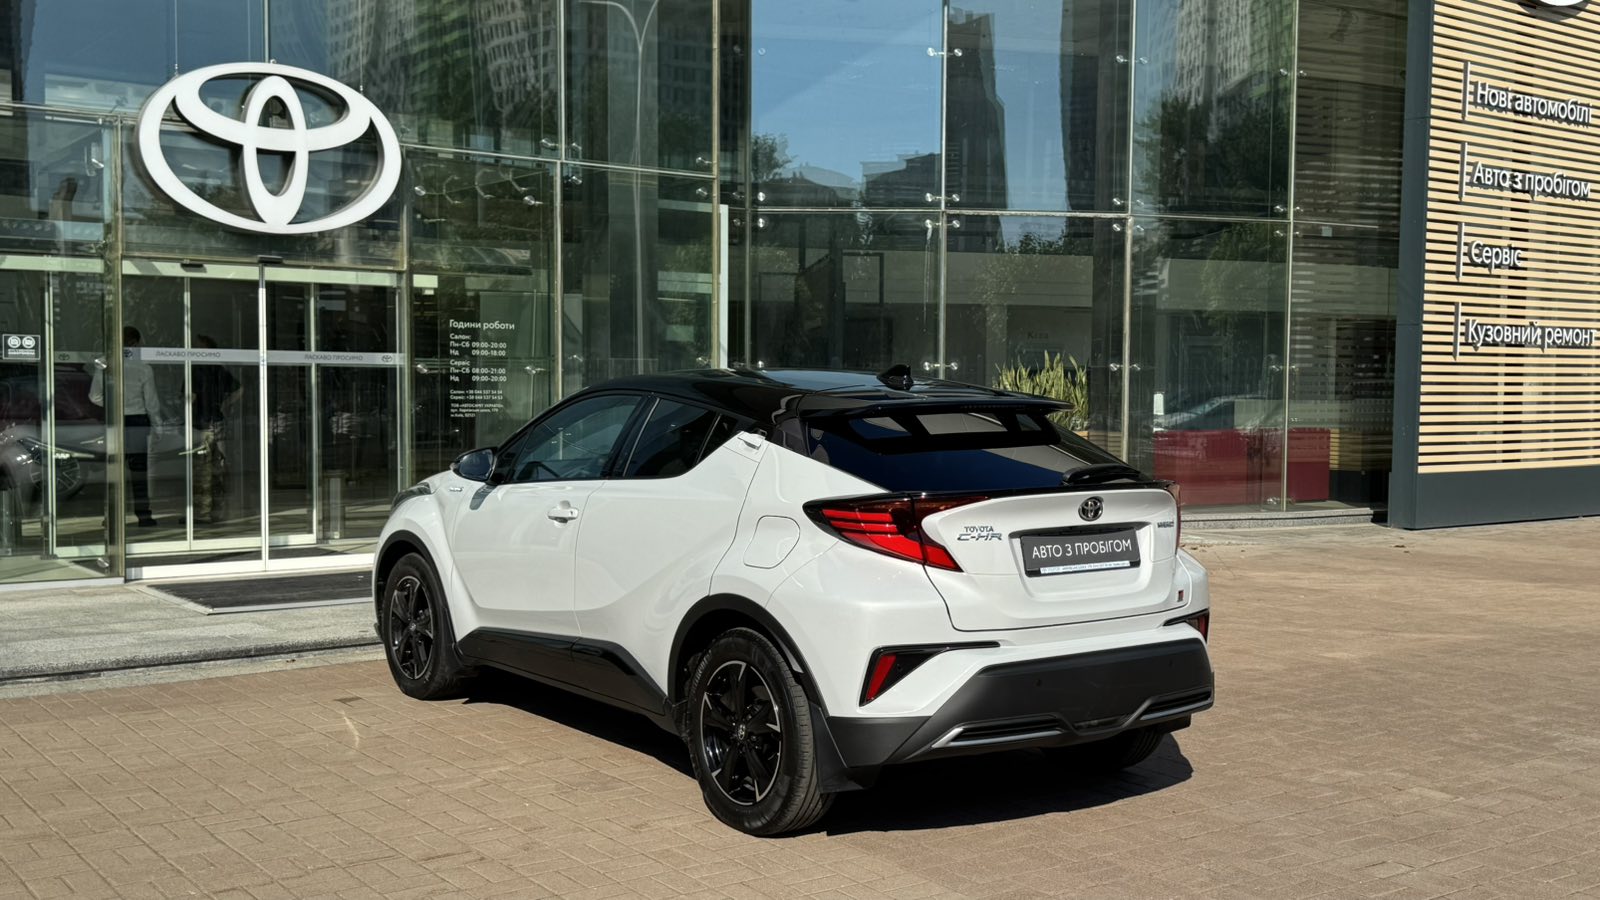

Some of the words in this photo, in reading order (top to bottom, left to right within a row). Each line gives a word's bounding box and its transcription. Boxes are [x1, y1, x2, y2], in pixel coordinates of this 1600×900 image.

[1477, 81, 1512, 109] Нові
[1515, 98, 1593, 123] автомобілі
[1473, 161, 1510, 187] Авто
[1512, 173, 1522, 189] з
[1525, 172, 1591, 197] пробігом
[1471, 240, 1522, 269] Сервіс
[450, 319, 481, 329] Години
[483, 321, 515, 331] роботи
[1468, 319, 1542, 346] Кузовний
[1545, 327, 1597, 349] ремонт
[957, 532, 1002, 541] C-HR
[964, 525, 994, 533] TOYOTA
[1032, 544, 1063, 559] АВТО
[1075, 538, 1132, 555] ПРОБІГОМ
